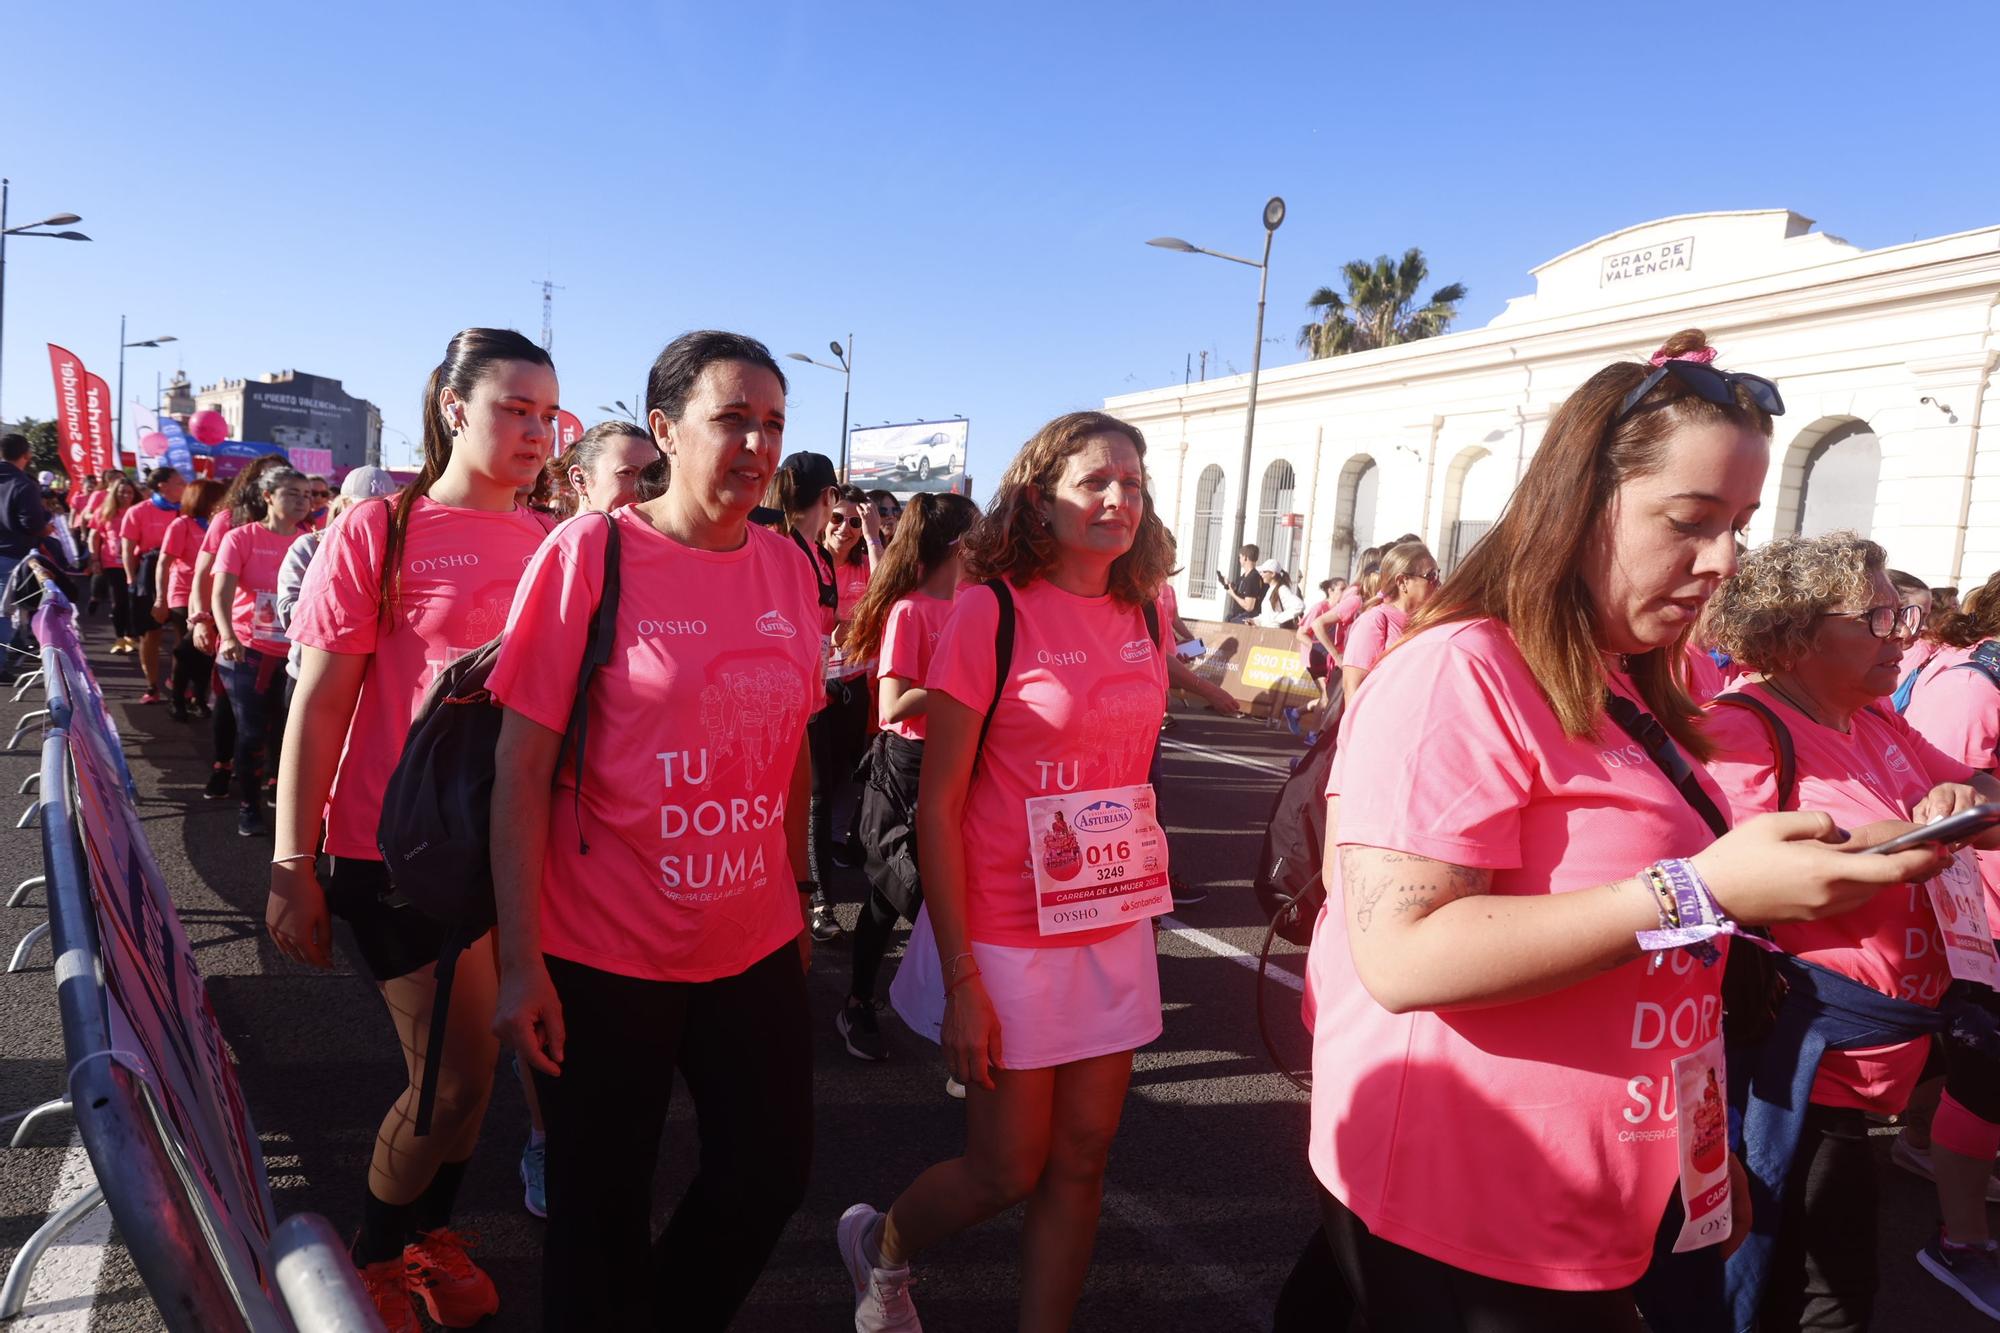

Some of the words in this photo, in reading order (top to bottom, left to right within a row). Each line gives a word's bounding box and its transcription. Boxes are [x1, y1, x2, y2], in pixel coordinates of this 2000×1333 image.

[1610, 251, 1652, 268] GRAO
[1661, 243, 1684, 258] DE
[1606, 256, 1685, 282] VALENCIA
[411, 553, 479, 574] OYSHO
[638, 619, 707, 635] OYSHO
[656, 748, 707, 788] TU
[1601, 744, 1648, 768] OYS
[1035, 760, 1079, 790] TU
[661, 791, 785, 839] DORSA
[1080, 812, 1129, 828] ASTURIANA
[1086, 840, 1131, 865] 016
[659, 843, 766, 888] SUMA
[1097, 865, 1124, 881] 3249
[1056, 889, 1095, 902] CARRERA
[1096, 888, 1107, 896] DE
[1108, 886, 1119, 894] LA
[1120, 882, 1144, 892] MUJER
[1130, 895, 1163, 911] Santander
[1053, 907, 1098, 924] OYSHO
[1631, 995, 1720, 1049] DOR
[1622, 1075, 1678, 1124] SU
